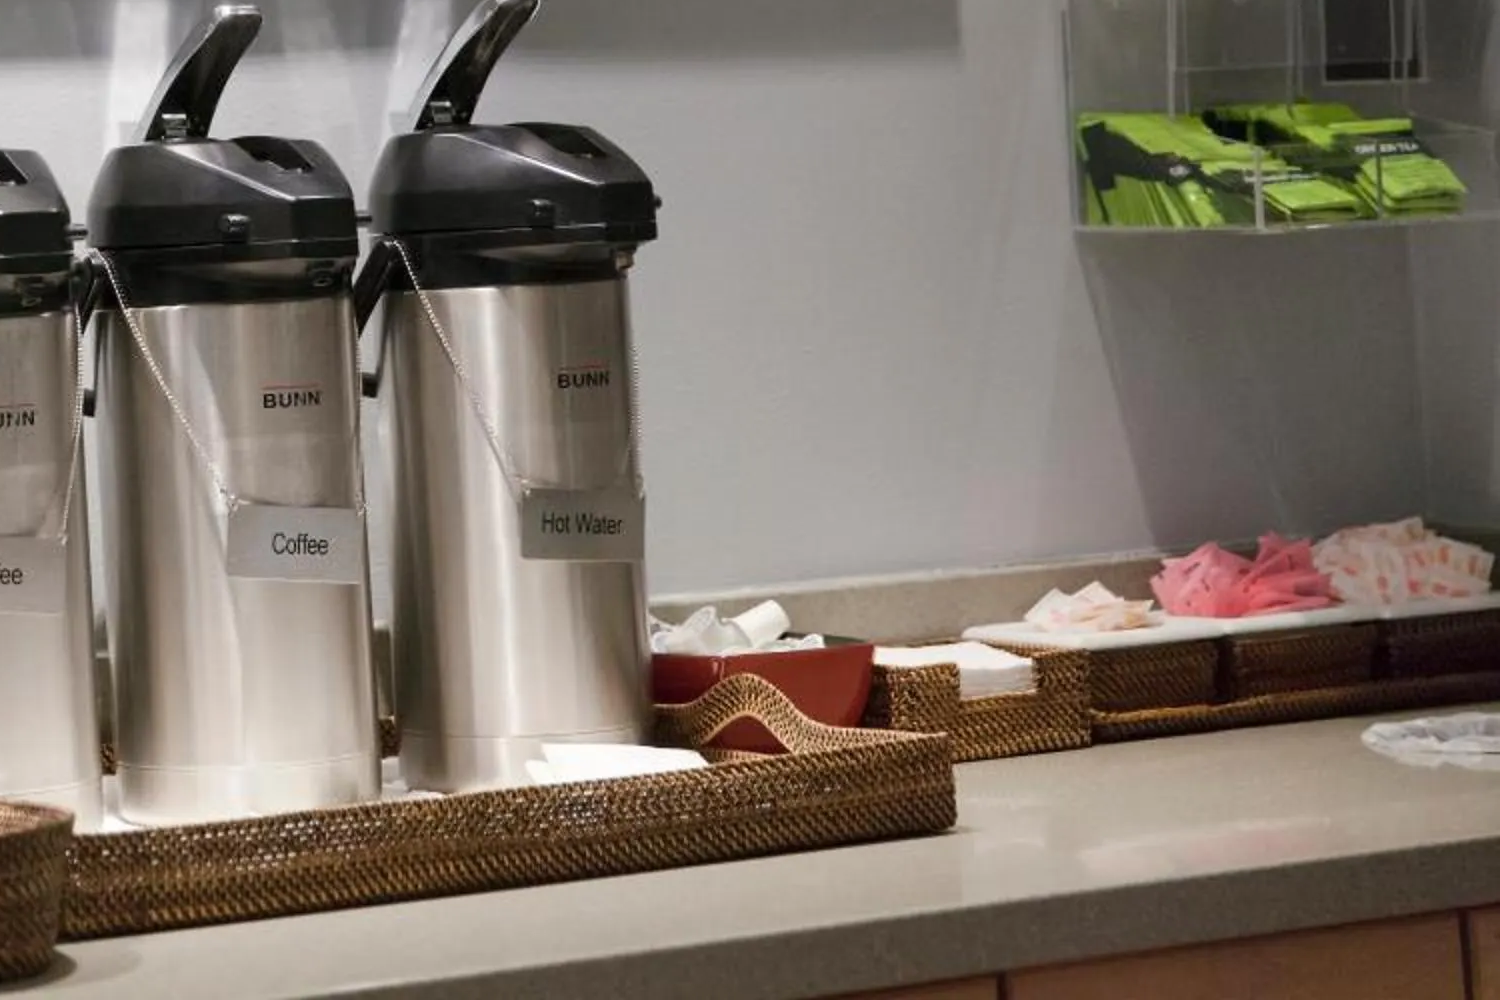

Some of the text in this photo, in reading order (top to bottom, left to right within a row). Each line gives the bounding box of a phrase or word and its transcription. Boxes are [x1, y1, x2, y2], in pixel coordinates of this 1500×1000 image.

[556, 370, 610, 389] BUNN
[262, 389, 321, 409] BUNN
[541, 512, 623, 535] Hot Water
[271, 532, 329, 556] Coffee
